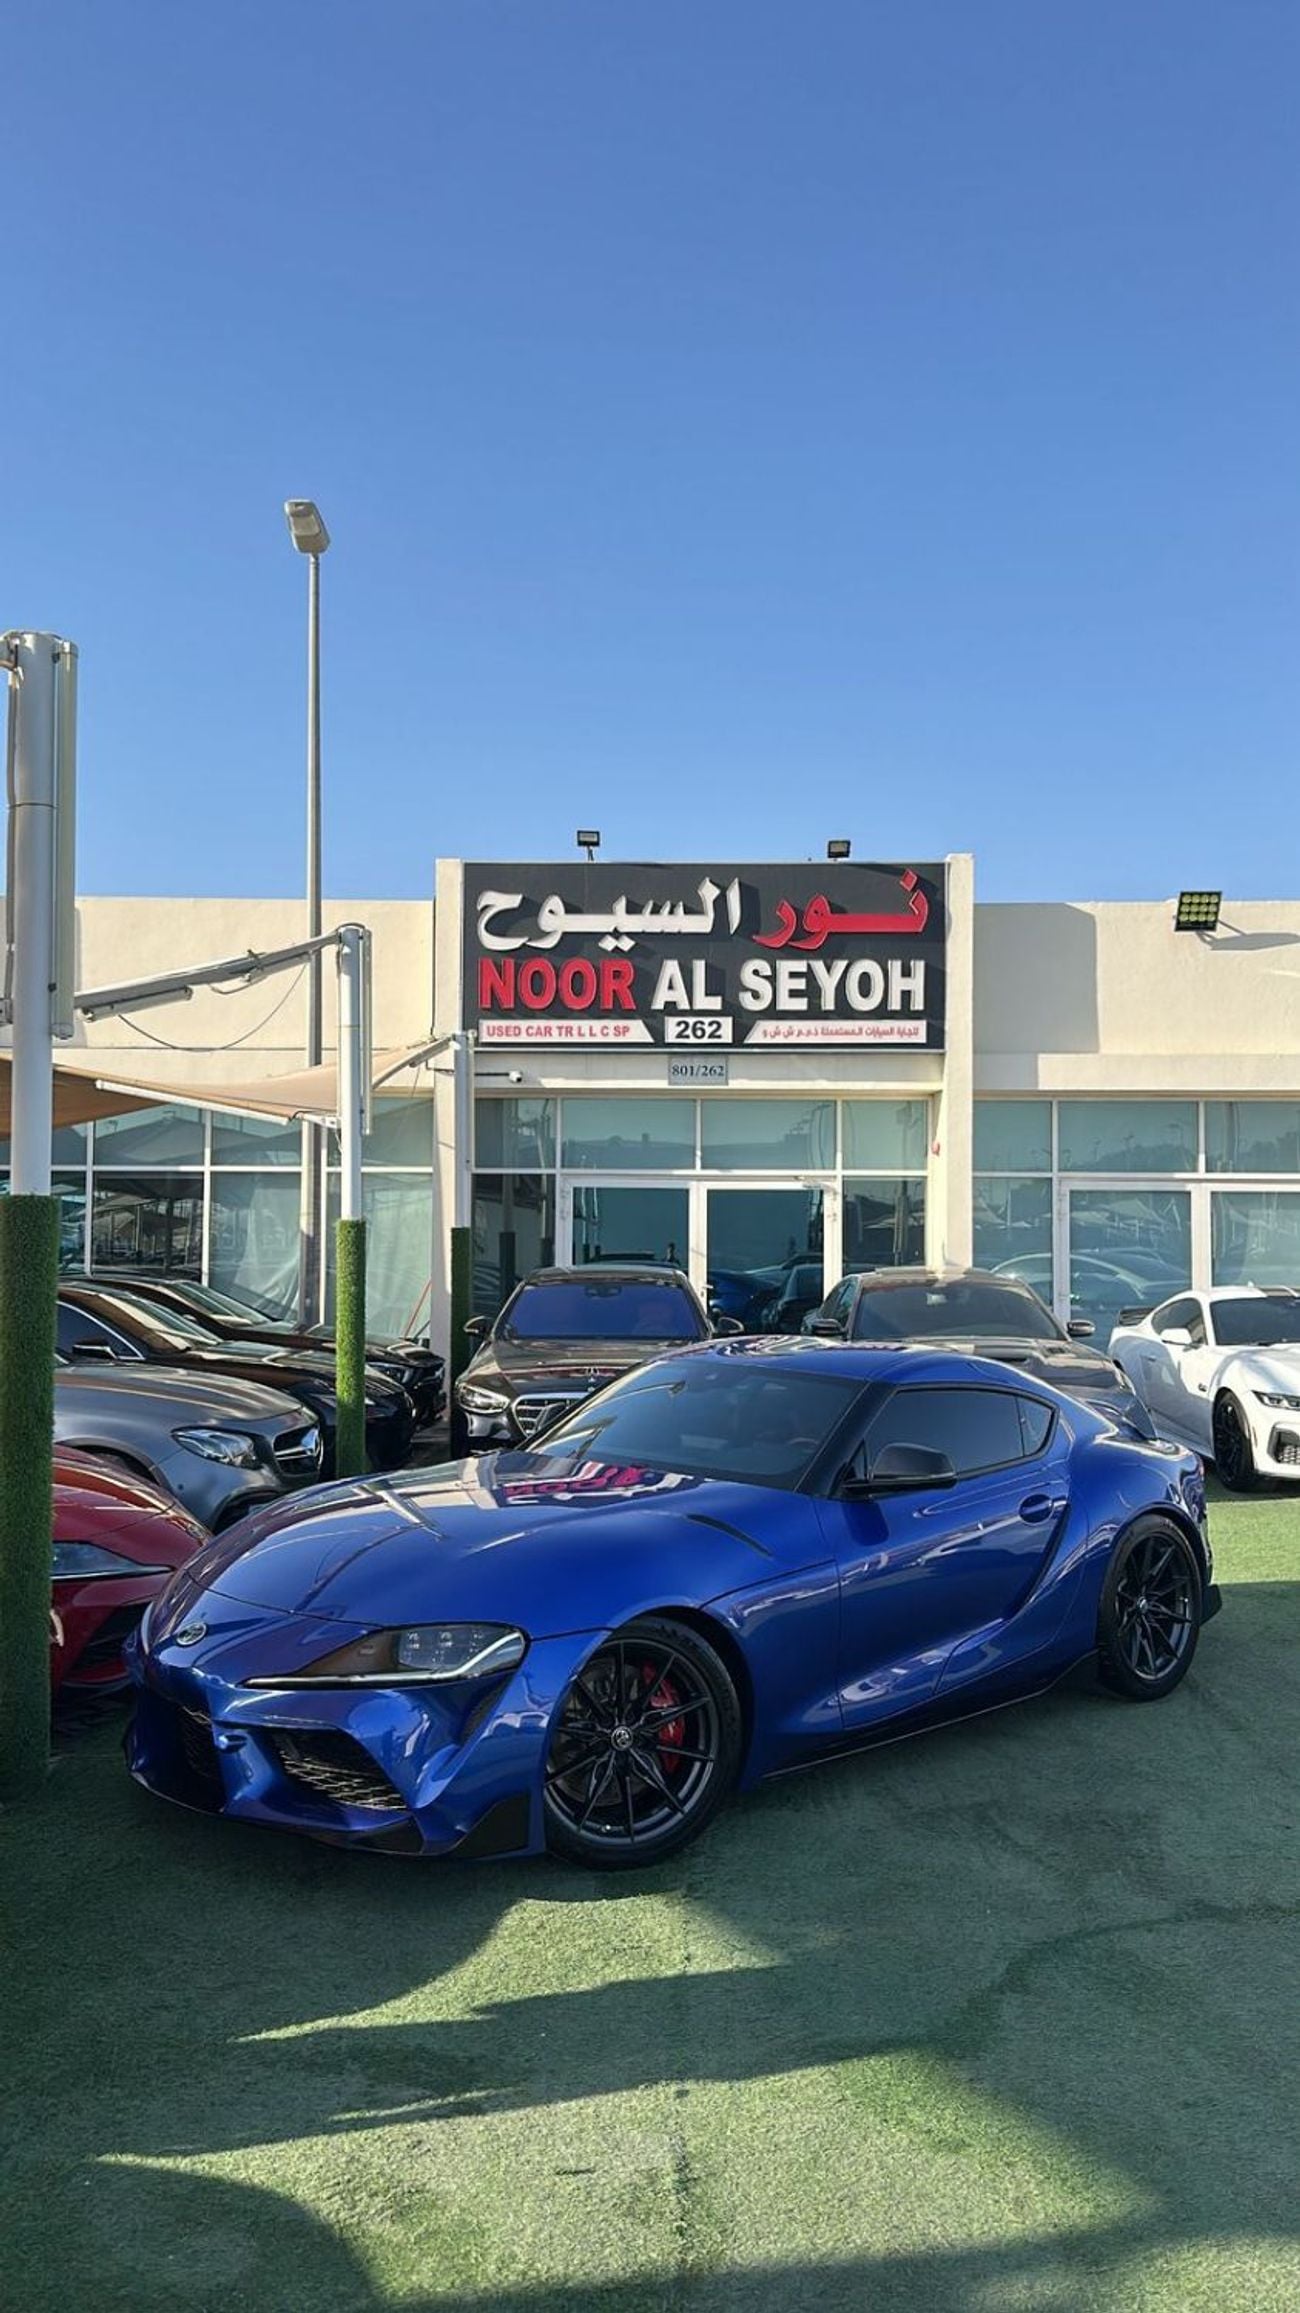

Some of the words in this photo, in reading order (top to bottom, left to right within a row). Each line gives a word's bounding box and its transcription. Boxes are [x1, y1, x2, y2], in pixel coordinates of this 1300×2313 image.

[477, 877, 741, 951] السيوح
[753, 868, 928, 950] نور
[478, 957, 637, 1010] NOOR
[651, 959, 722, 1010] AL
[739, 959, 925, 1011] SEYOH
[487, 1025, 521, 1037] USED
[526, 1025, 552, 1037] CAR
[557, 1025, 573, 1037] TR
[578, 1025, 585, 1037] L
[589, 1025, 597, 1037] L
[600, 1025, 609, 1037] C
[614, 1025, 630, 1037] SP
[675, 1020, 723, 1039] 262
[671, 1064, 725, 1077] 801/262
